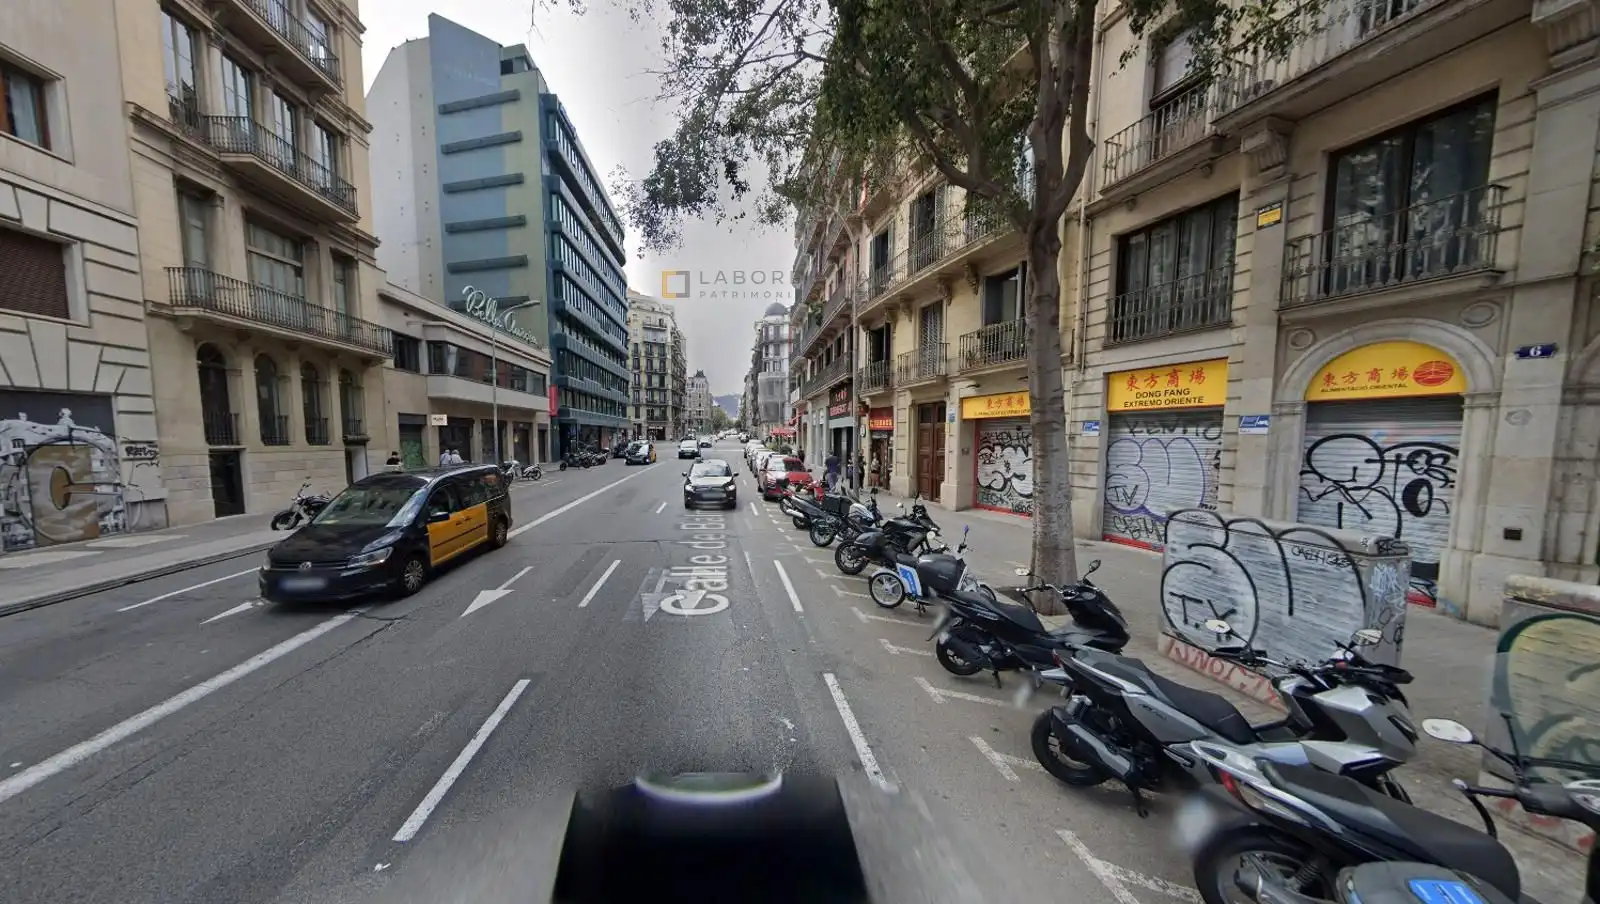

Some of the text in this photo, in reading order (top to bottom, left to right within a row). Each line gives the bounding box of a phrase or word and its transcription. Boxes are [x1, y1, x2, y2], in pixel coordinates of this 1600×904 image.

[1529, 345, 1542, 357] 6
[1126, 367, 1206, 391] 東方商場
[1322, 366, 1409, 387] 東方商場
[1135, 388, 1190, 399] DONG FANG
[1123, 396, 1204, 408] EXTREMO ORIENTE
